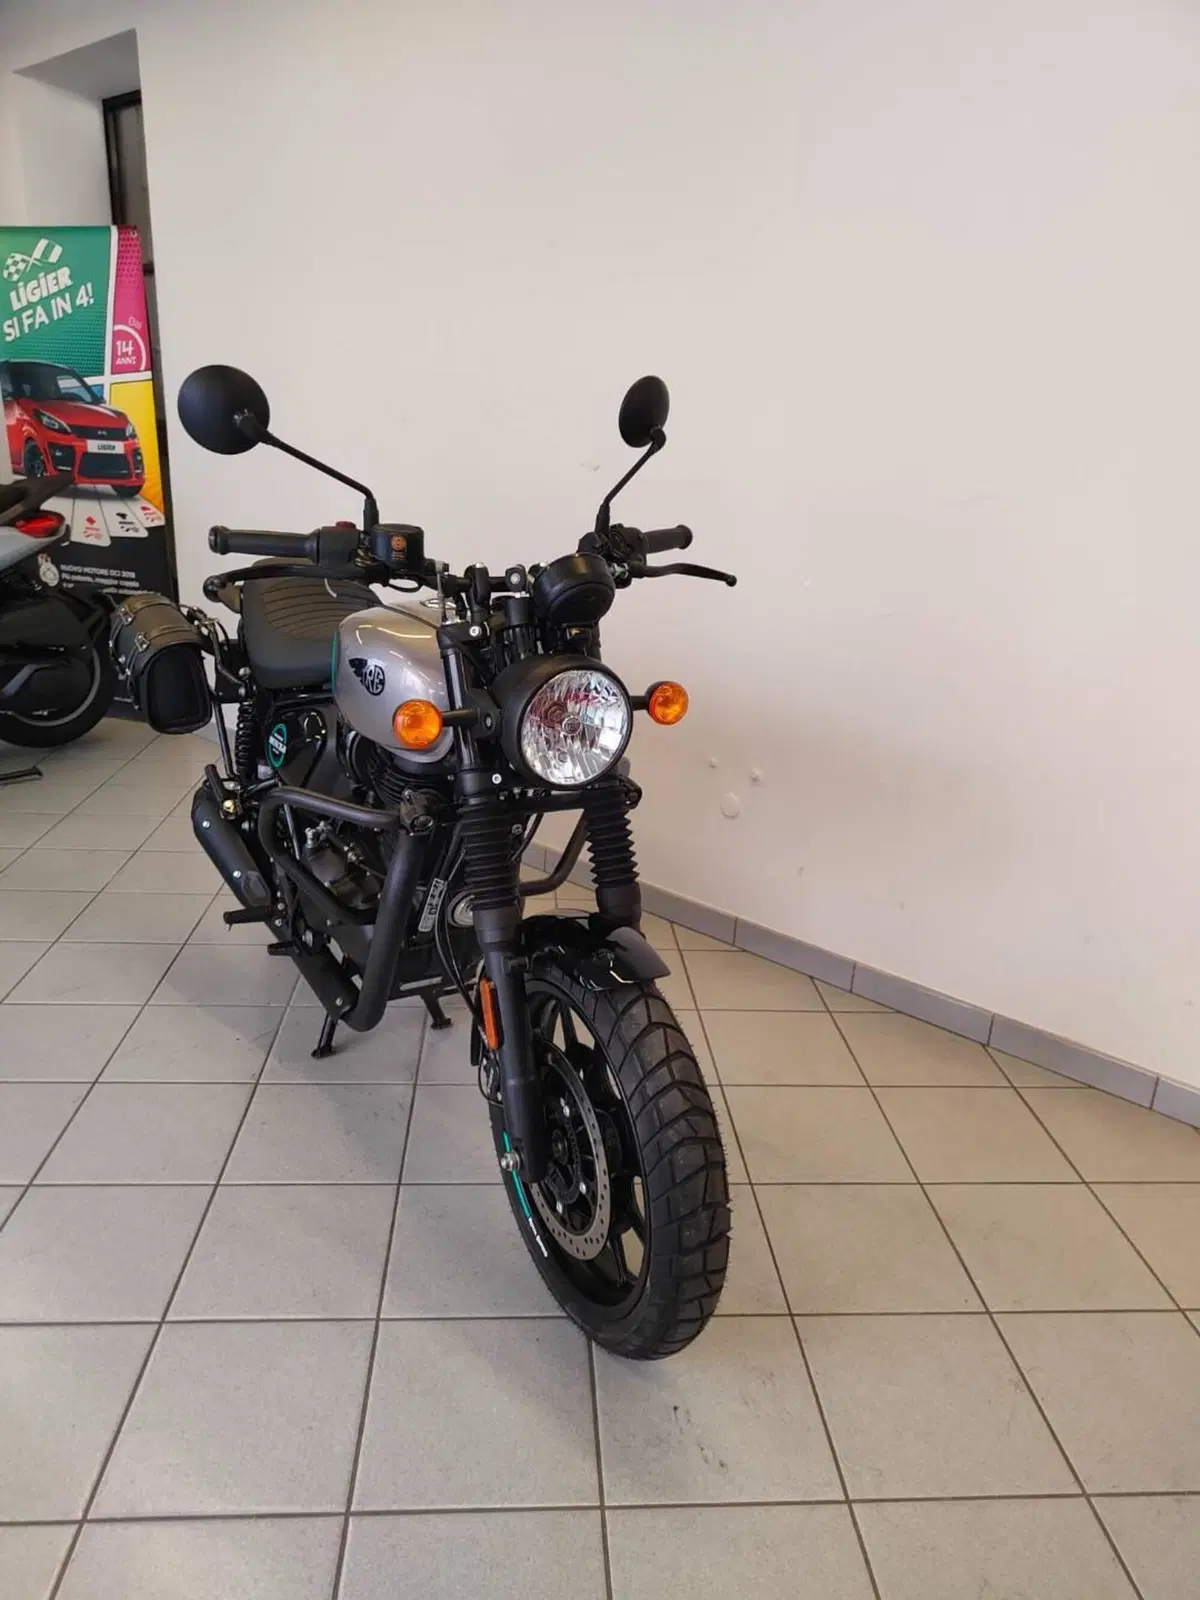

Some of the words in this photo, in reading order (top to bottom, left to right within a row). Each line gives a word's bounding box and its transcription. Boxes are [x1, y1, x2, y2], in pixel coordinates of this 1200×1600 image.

[9, 266, 73, 311] LIGIER
[3, 318, 20, 342] SI
[22, 306, 49, 334] FA
[51, 293, 72, 321] IN
[76, 282, 95, 307] 4!
[116, 340, 134, 356] 14
